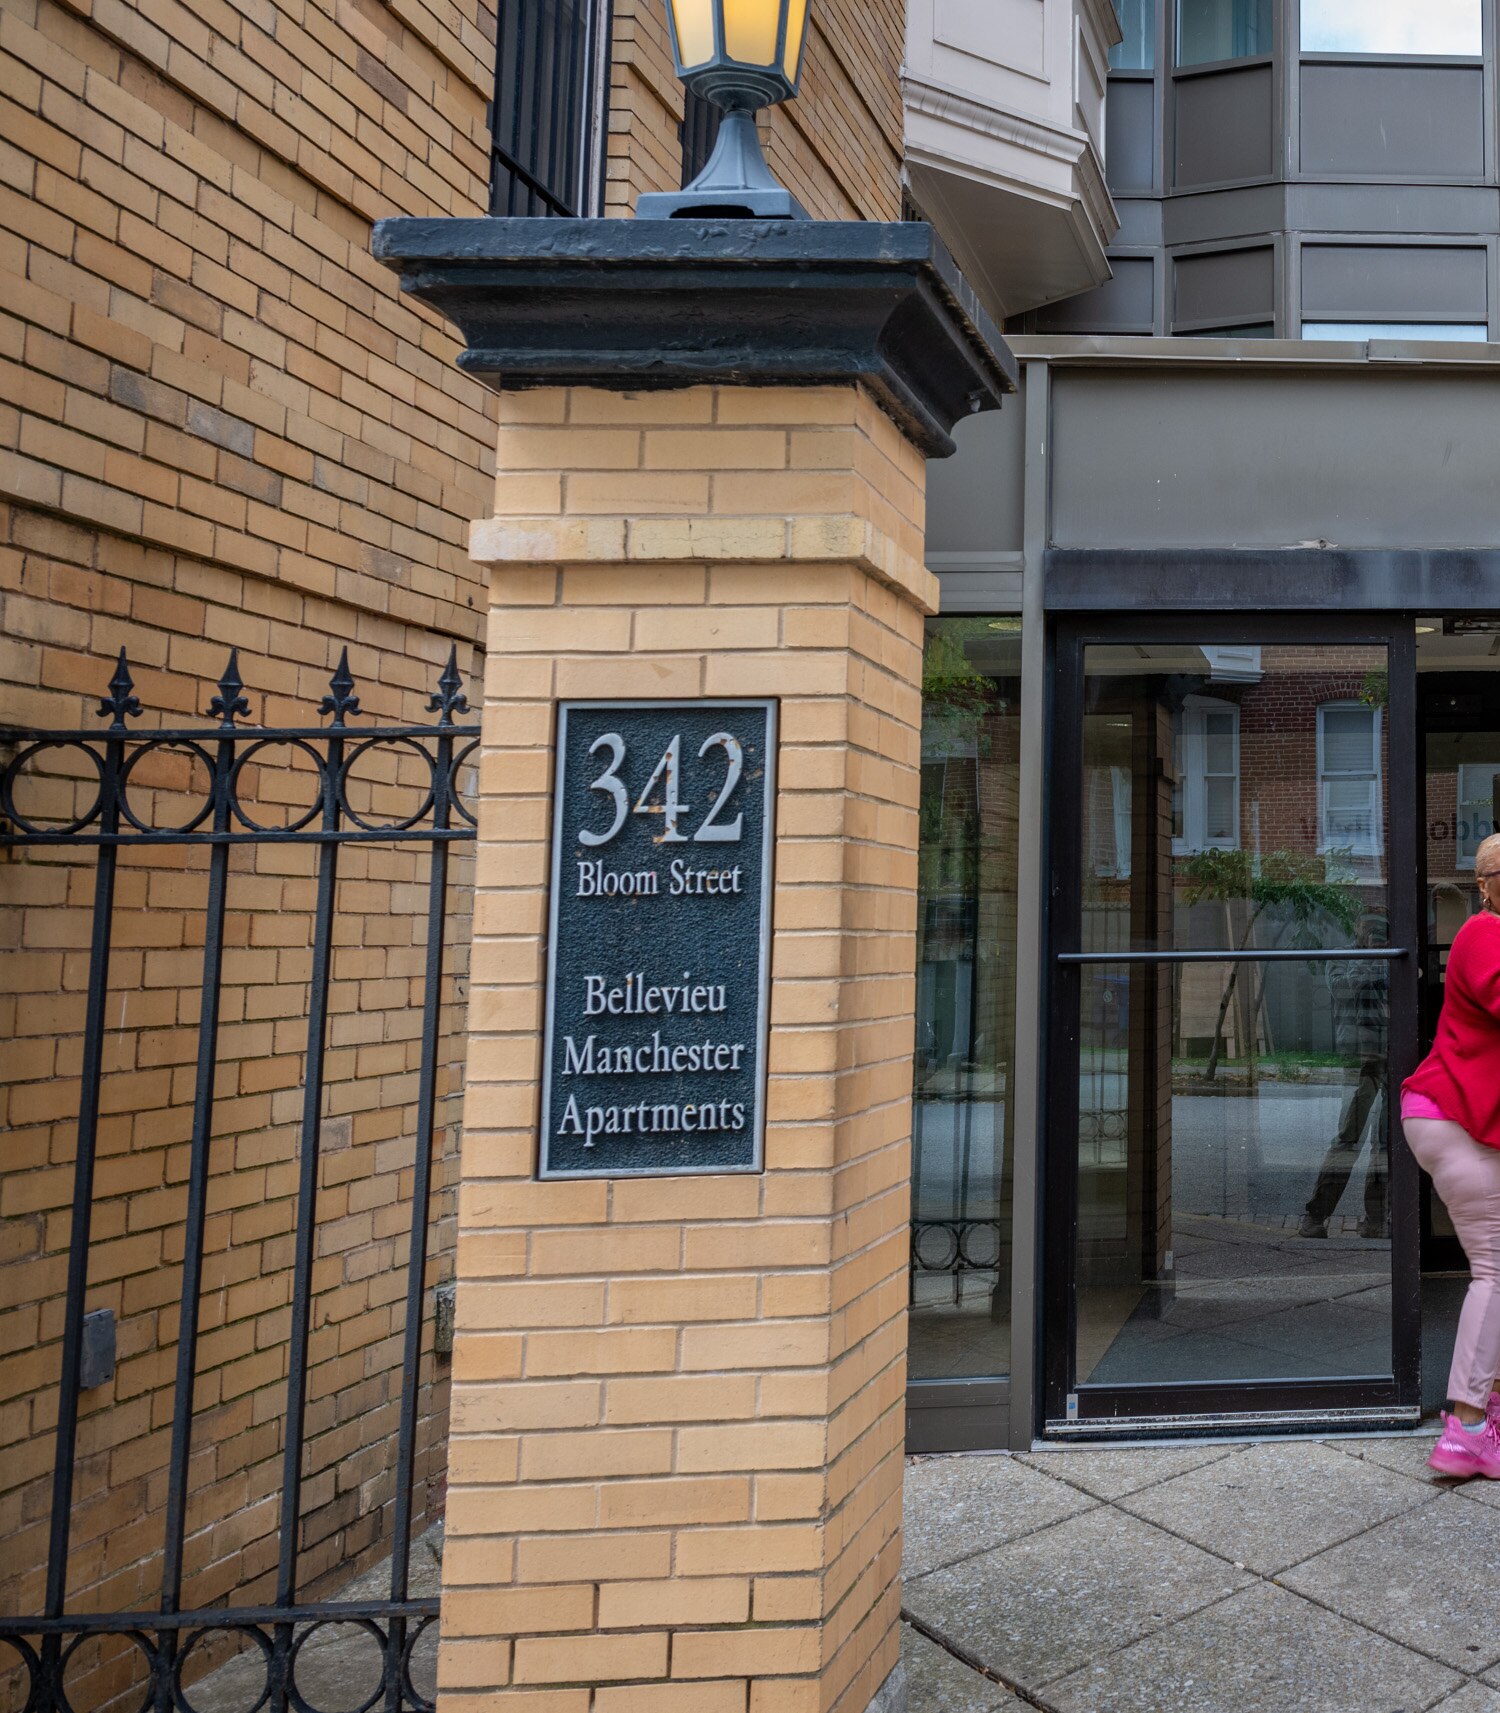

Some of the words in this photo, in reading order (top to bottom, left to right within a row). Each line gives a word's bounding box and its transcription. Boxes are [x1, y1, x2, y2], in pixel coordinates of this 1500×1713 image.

[578, 731, 744, 846] 342
[576, 861, 659, 897] Bloom
[669, 859, 742, 895] Street
[583, 971, 727, 1016] Bellevieu
[562, 1031, 744, 1075] Manchester
[556, 1092, 745, 1147] Apartments
